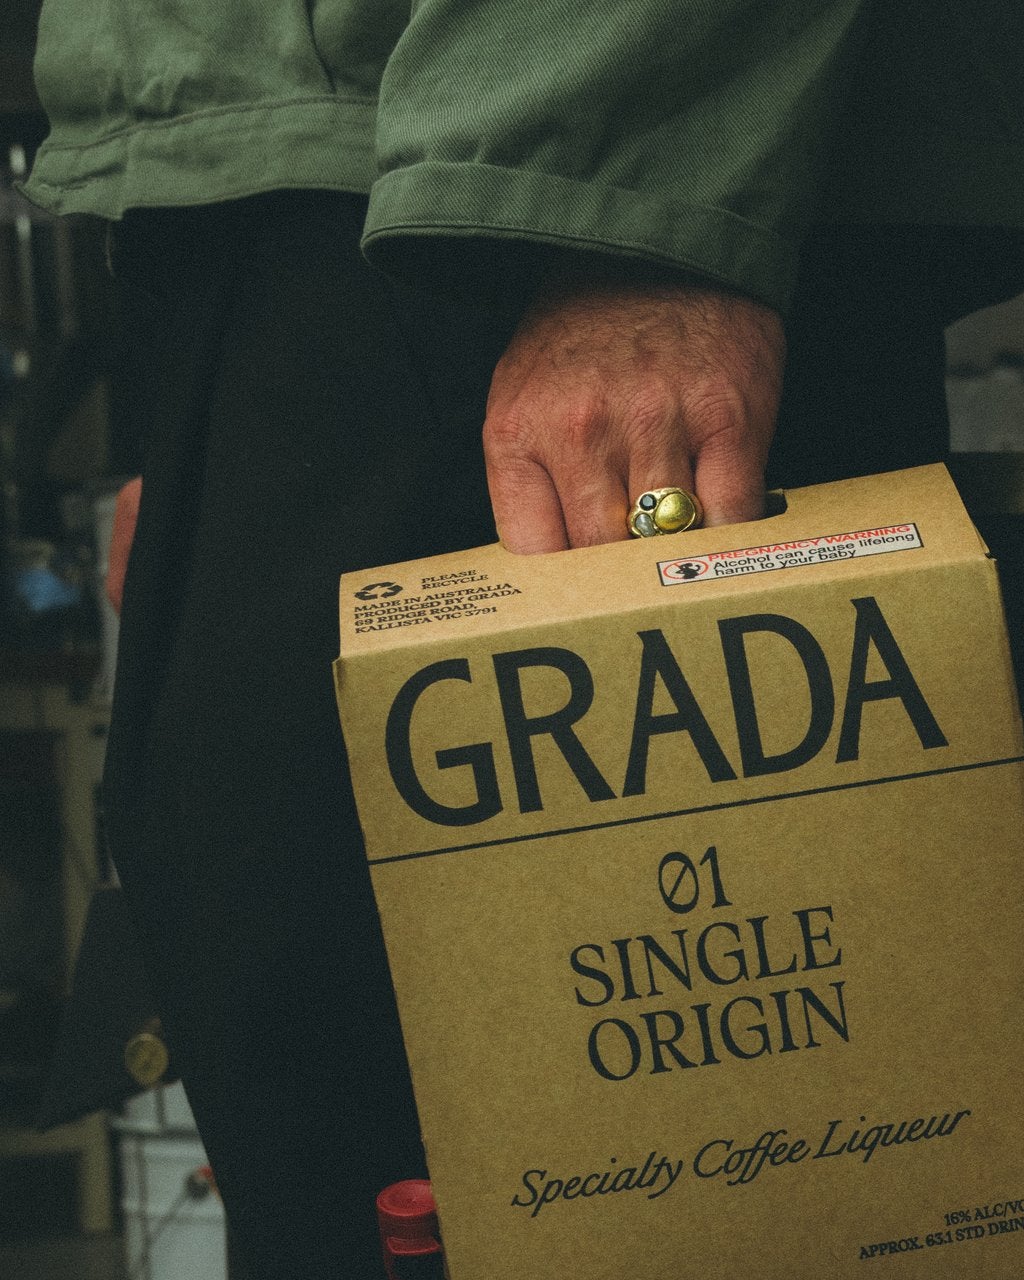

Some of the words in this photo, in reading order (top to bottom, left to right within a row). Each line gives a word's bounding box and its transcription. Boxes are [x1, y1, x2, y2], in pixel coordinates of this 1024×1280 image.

[708, 538, 821, 562] PREGNANCY
[824, 525, 911, 544] WARNING
[713, 553, 770, 570] Alcohol
[775, 548, 805, 559] can
[808, 541, 855, 556] cause
[859, 532, 915, 548] lifelong
[421, 569, 477, 584] PLEASE
[714, 564, 755, 576] harm
[760, 560, 775, 570] to
[779, 555, 815, 569] your
[819, 548, 857, 562] baby
[354, 600, 401, 612] MADE
[404, 596, 421, 605] IN
[423, 583, 513, 601] AUSTRALIA
[421, 574, 489, 590] RECYCLE
[354, 601, 442, 620] PRODUCED
[445, 596, 465, 605] BY
[467, 588, 523, 601] GRADA
[354, 618, 374, 627] 69
[377, 609, 427, 623] RIDGE
[430, 603, 478, 615] ROAD,
[355, 617, 433, 634] KALLISTA
[434, 612, 462, 622] VIC
[464, 606, 498, 618] 3791
[385, 596, 950, 828] GRADA
[658, 846, 733, 914] 01
[569, 905, 843, 1008] SINGLE
[587, 980, 850, 1082] ORIGIN
[510, 1150, 685, 1219] Specialty
[692, 1128, 812, 1187] Coffee
[812, 1108, 971, 1164] Liqueur
[944, 1209, 972, 1227] 16%
[859, 1236, 924, 1260] APPROX.
[925, 1231, 954, 1248] 63.1
[956, 1225, 986, 1242] STD
